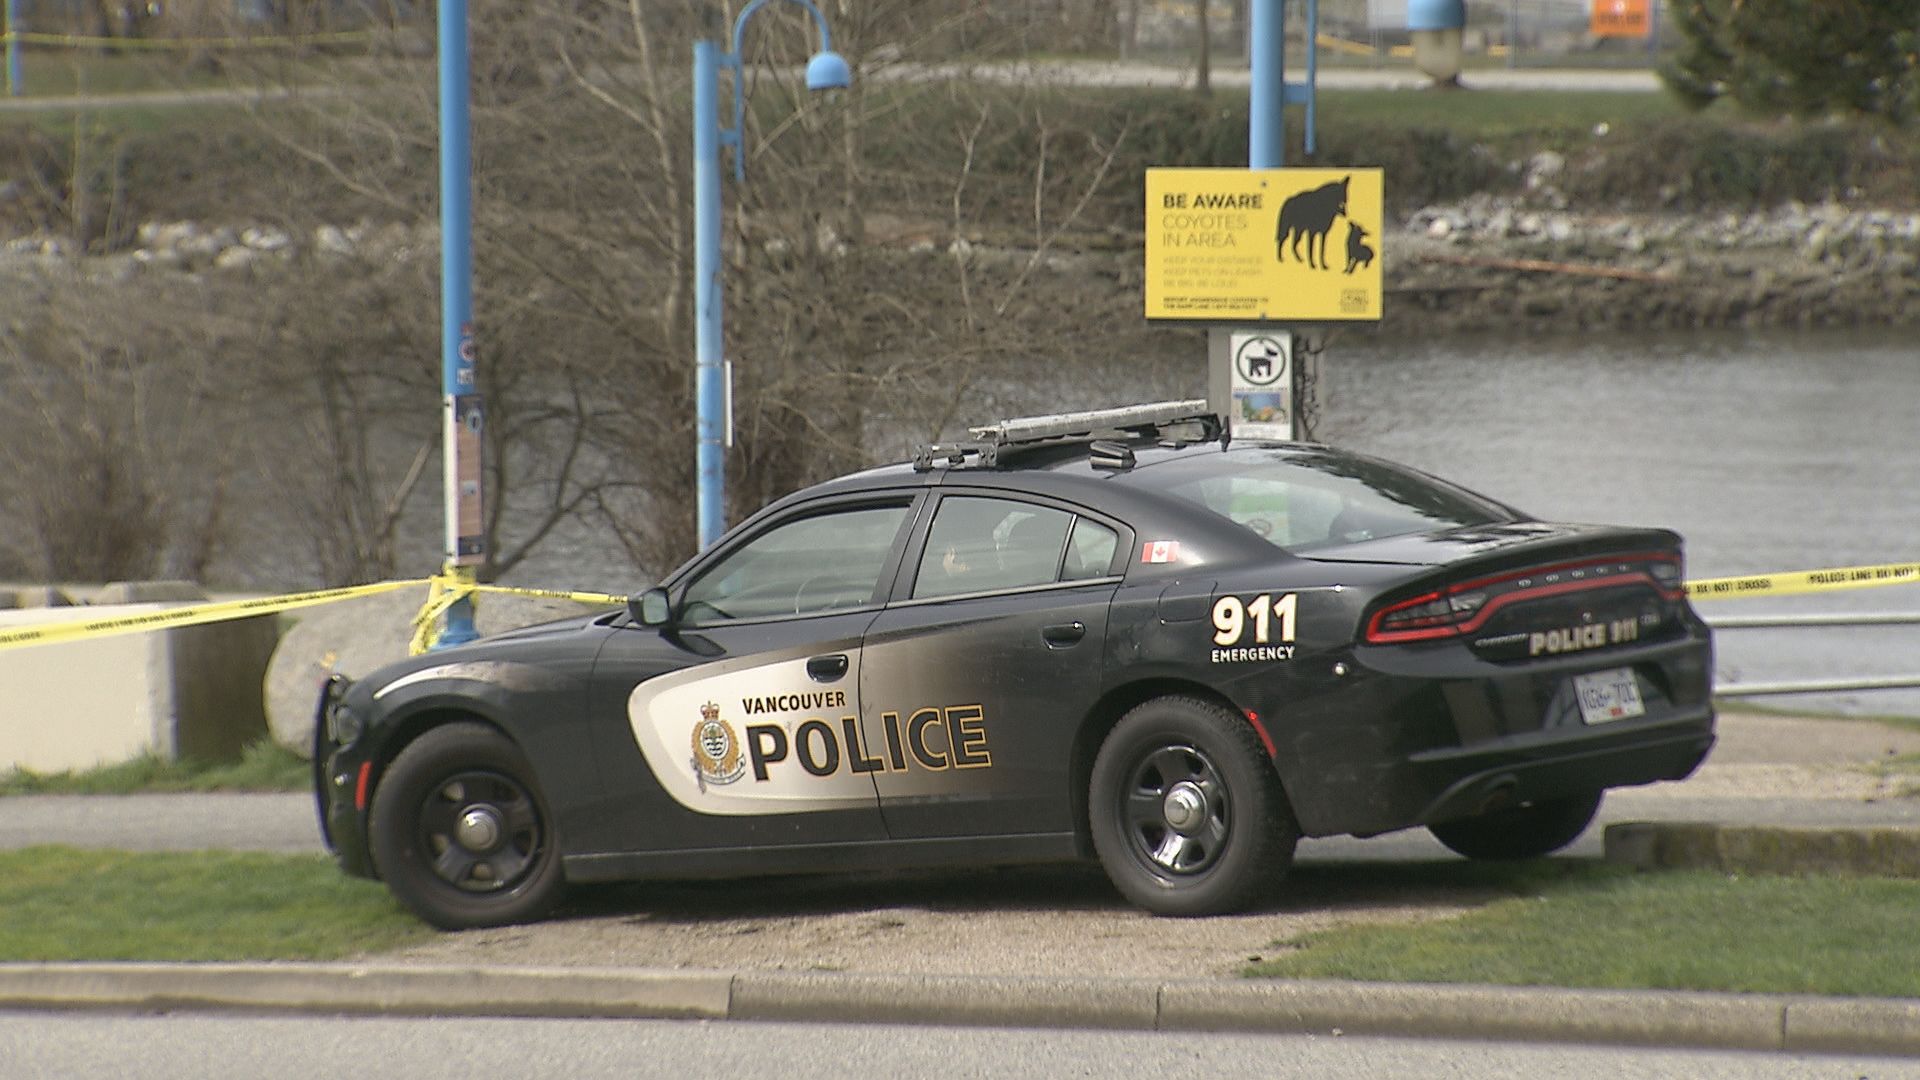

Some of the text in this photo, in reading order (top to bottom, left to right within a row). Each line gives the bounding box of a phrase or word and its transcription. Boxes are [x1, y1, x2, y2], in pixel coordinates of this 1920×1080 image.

[1163, 193, 1262, 209] BE AWARE
[1162, 213, 1248, 230] COYOTES
[1163, 232, 1237, 248] IN AREA
[1211, 591, 1298, 647] 911
[1529, 623, 1607, 656] POLICE
[1610, 617, 1638, 643] 911
[1211, 645, 1296, 663] EMERGENCY
[742, 691, 846, 715] VANCOUVER
[746, 704, 992, 782] POLICE
